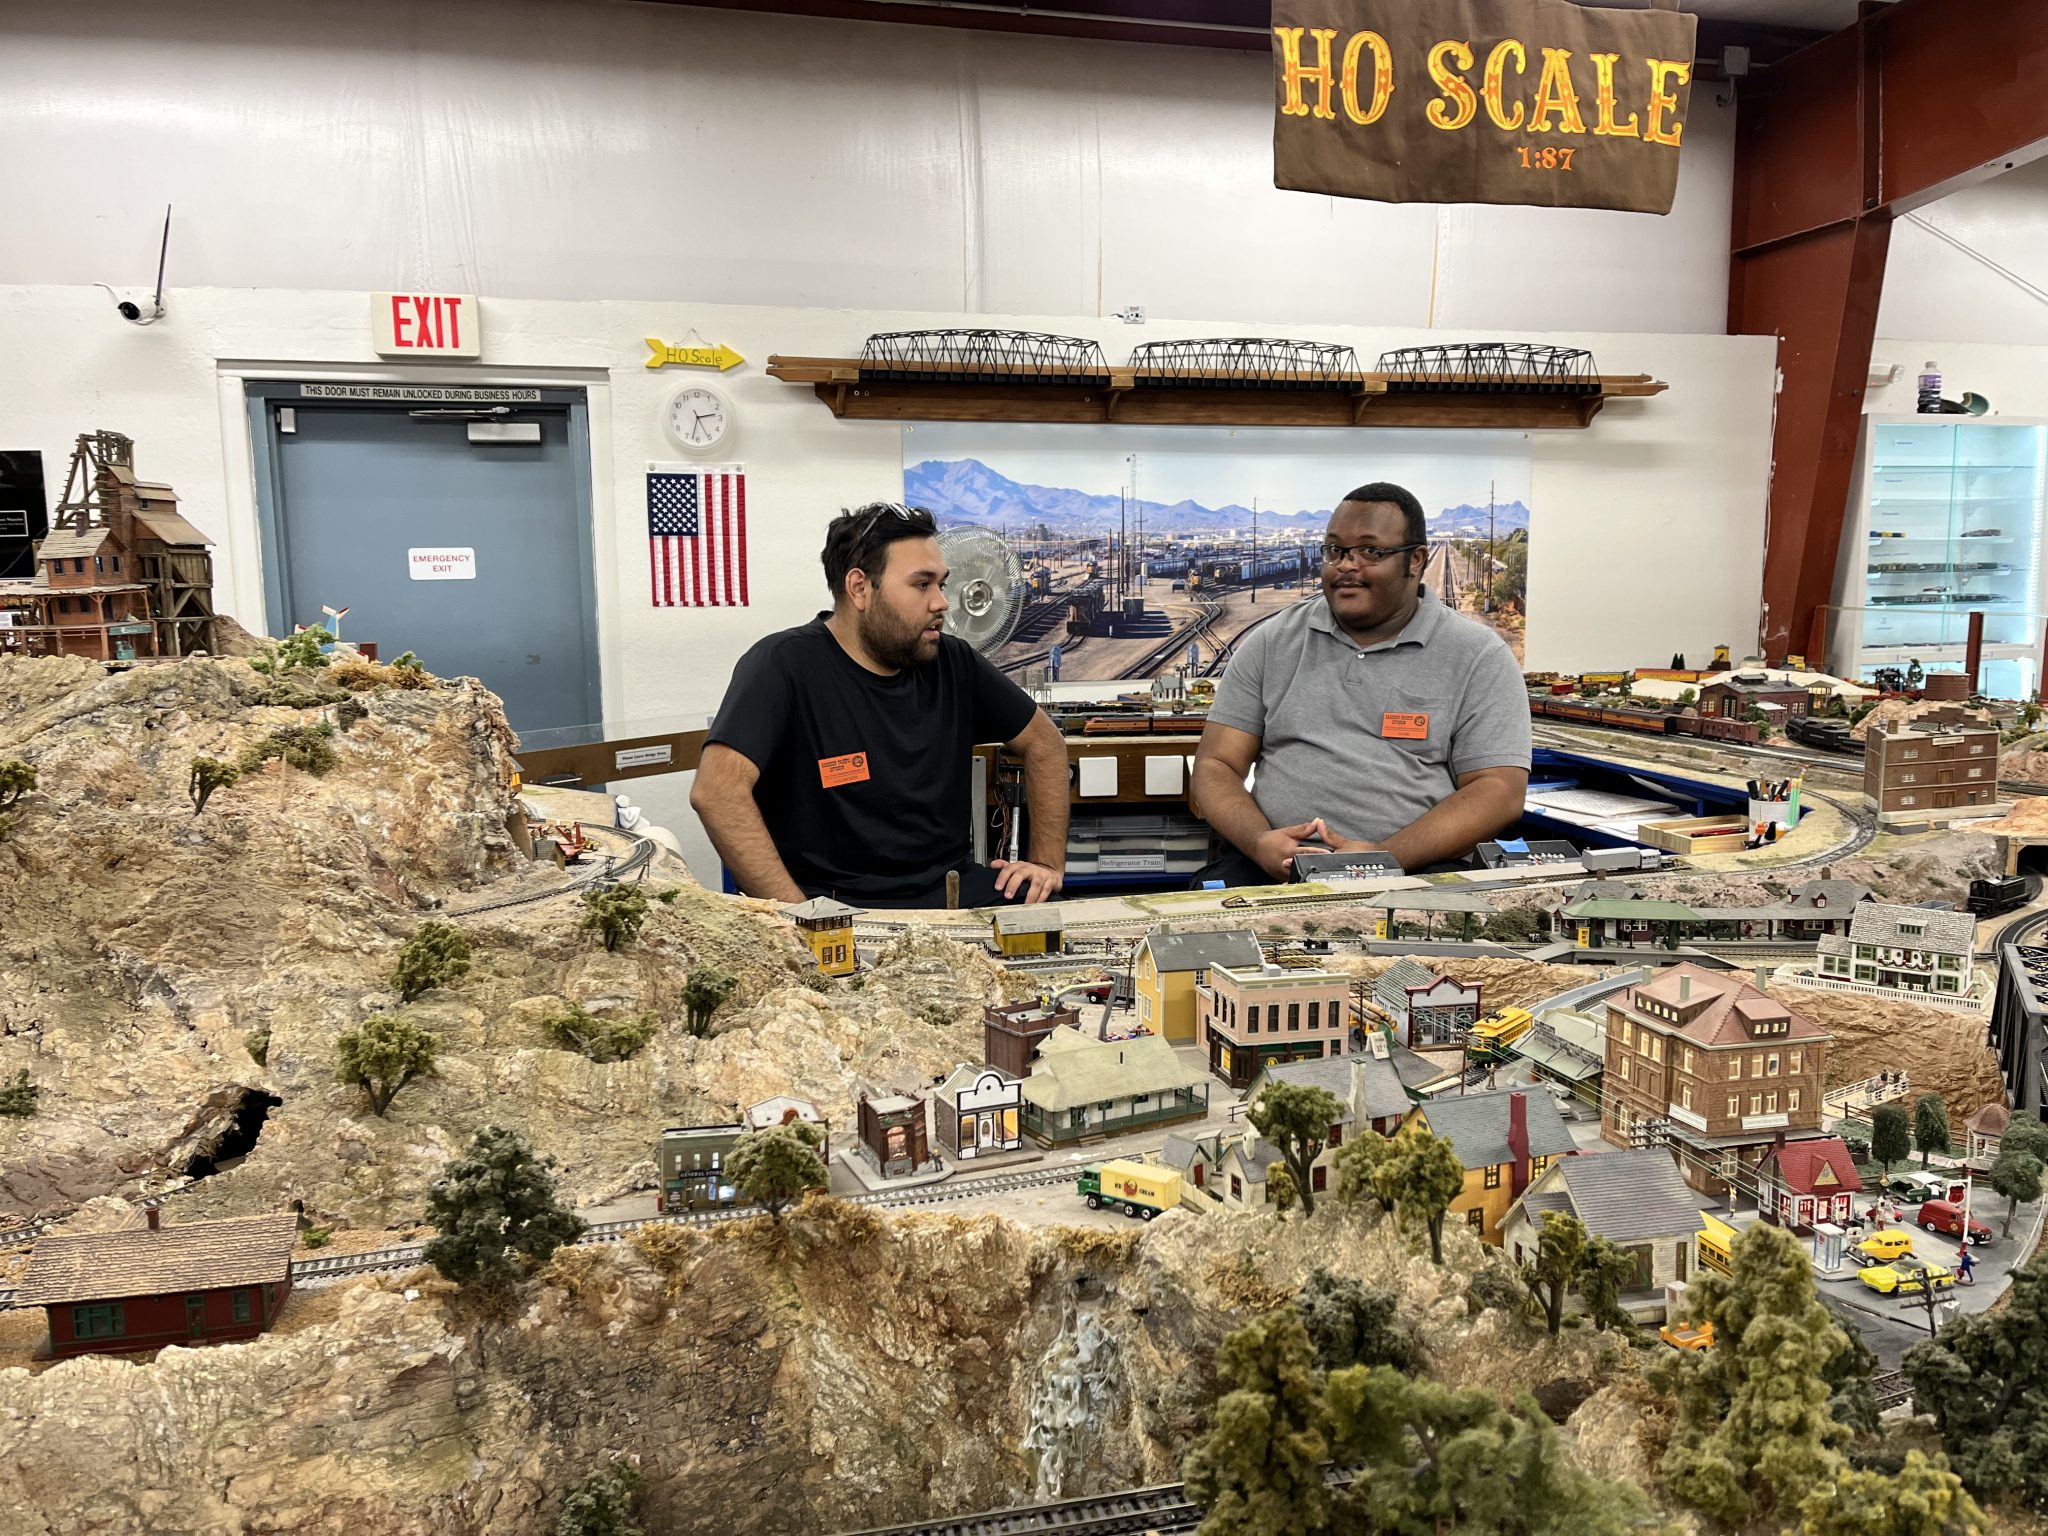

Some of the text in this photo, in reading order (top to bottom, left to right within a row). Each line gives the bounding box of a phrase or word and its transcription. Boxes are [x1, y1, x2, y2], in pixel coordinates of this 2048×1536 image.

[1274, 27, 1692, 148] HO SCALE
[1516, 146, 1576, 171] 1:87
[392, 296, 461, 348] EXIT
[666, 347, 723, 365] HO Scale
[305, 386, 537, 400] THIS DOOR MUST REMAIN UNLOCKED DURING BUSINESS HOURS
[1101, 860, 1141, 868] Refrigerator
[1139, 1189, 1155, 1197] CREAM
